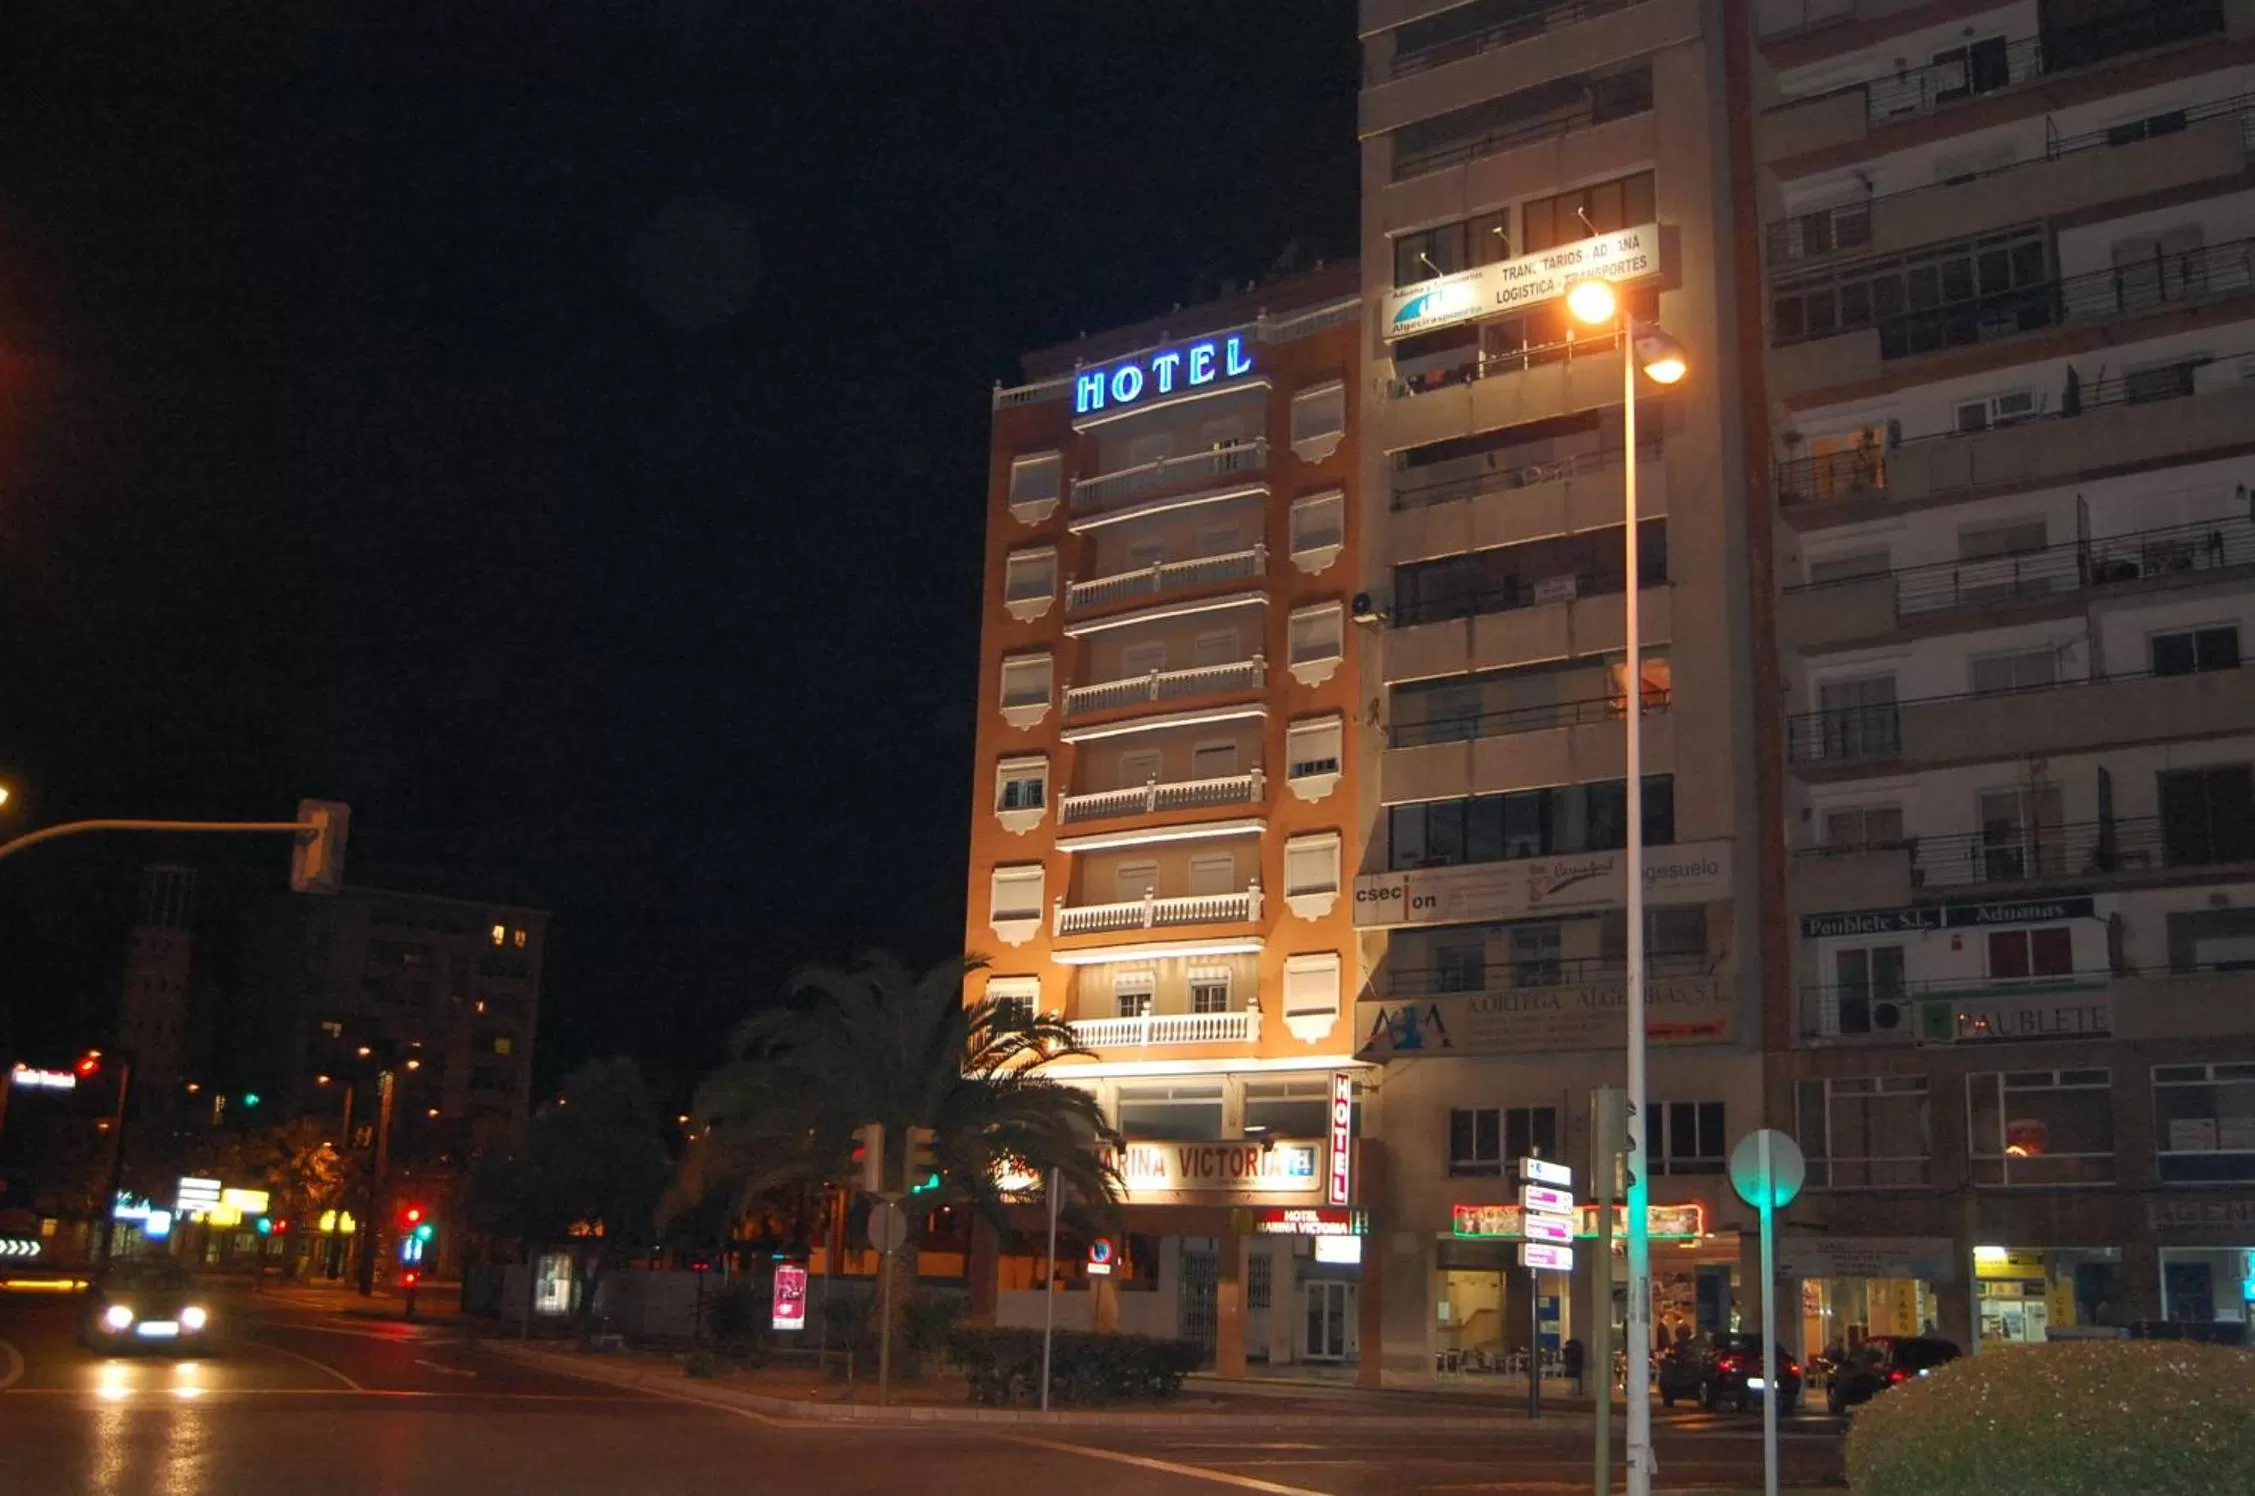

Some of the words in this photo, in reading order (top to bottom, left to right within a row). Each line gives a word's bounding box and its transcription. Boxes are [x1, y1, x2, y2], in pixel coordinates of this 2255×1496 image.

[1502, 249, 1583, 282] TRANTARIOS
[1496, 278, 1555, 304] LOGISTICA
[1075, 338, 1252, 413] HOTEL
[1642, 857, 1720, 890] gesuelo
[1809, 916, 1892, 936] Paublete
[1975, 903, 2066, 924] Aduanas
[1956, 1006, 2109, 1038] PAUBLETE
[1333, 1074, 1349, 1202] HOTEL
[1098, 1147, 1166, 1178] ARINA
[1178, 1147, 1283, 1178] VICTORIA
[1283, 1210, 1319, 1222] HOTEL
[1299, 1222, 1348, 1234] VICTORIA
